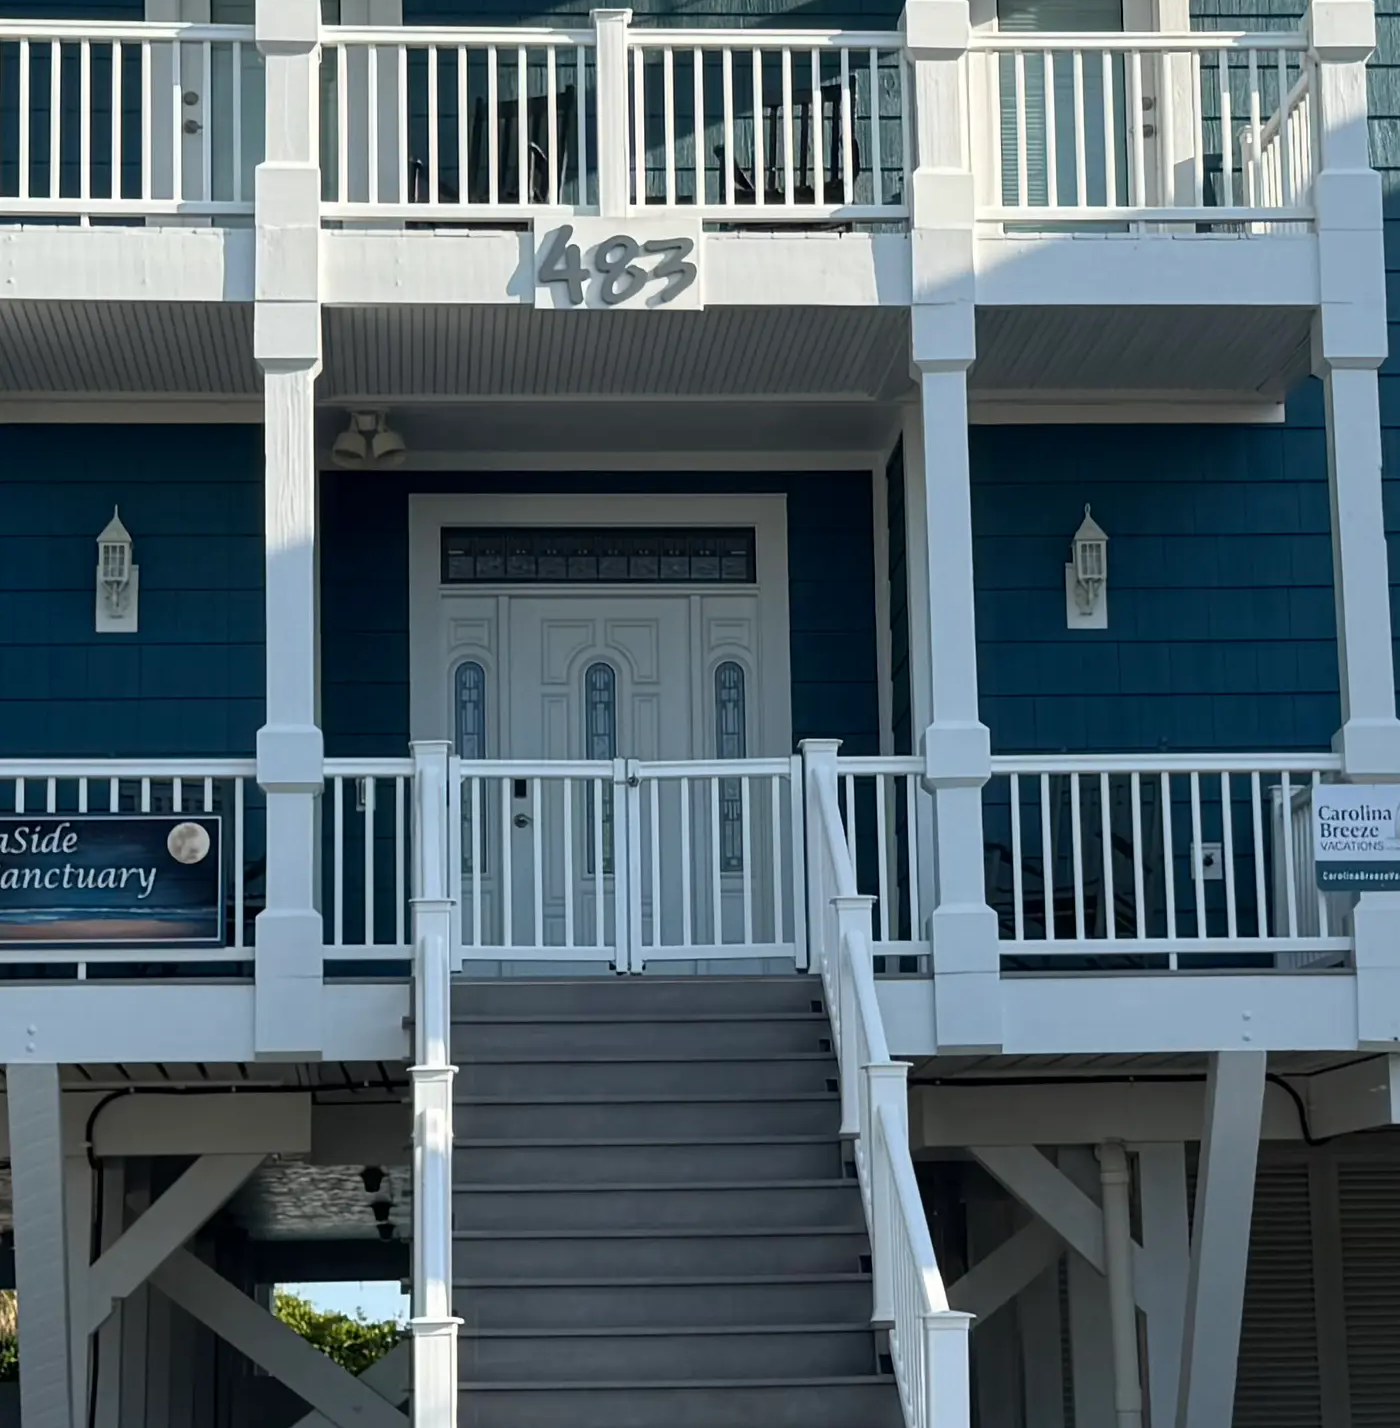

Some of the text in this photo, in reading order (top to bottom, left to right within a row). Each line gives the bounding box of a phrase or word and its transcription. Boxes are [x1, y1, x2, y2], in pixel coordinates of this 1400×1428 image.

[538, 224, 698, 305] 483
[1318, 805, 1392, 821] Carolina
[1320, 823, 1379, 838] Breeze
[1321, 841, 1384, 851] VACATIONS
[0, 863, 157, 899] anctuary
